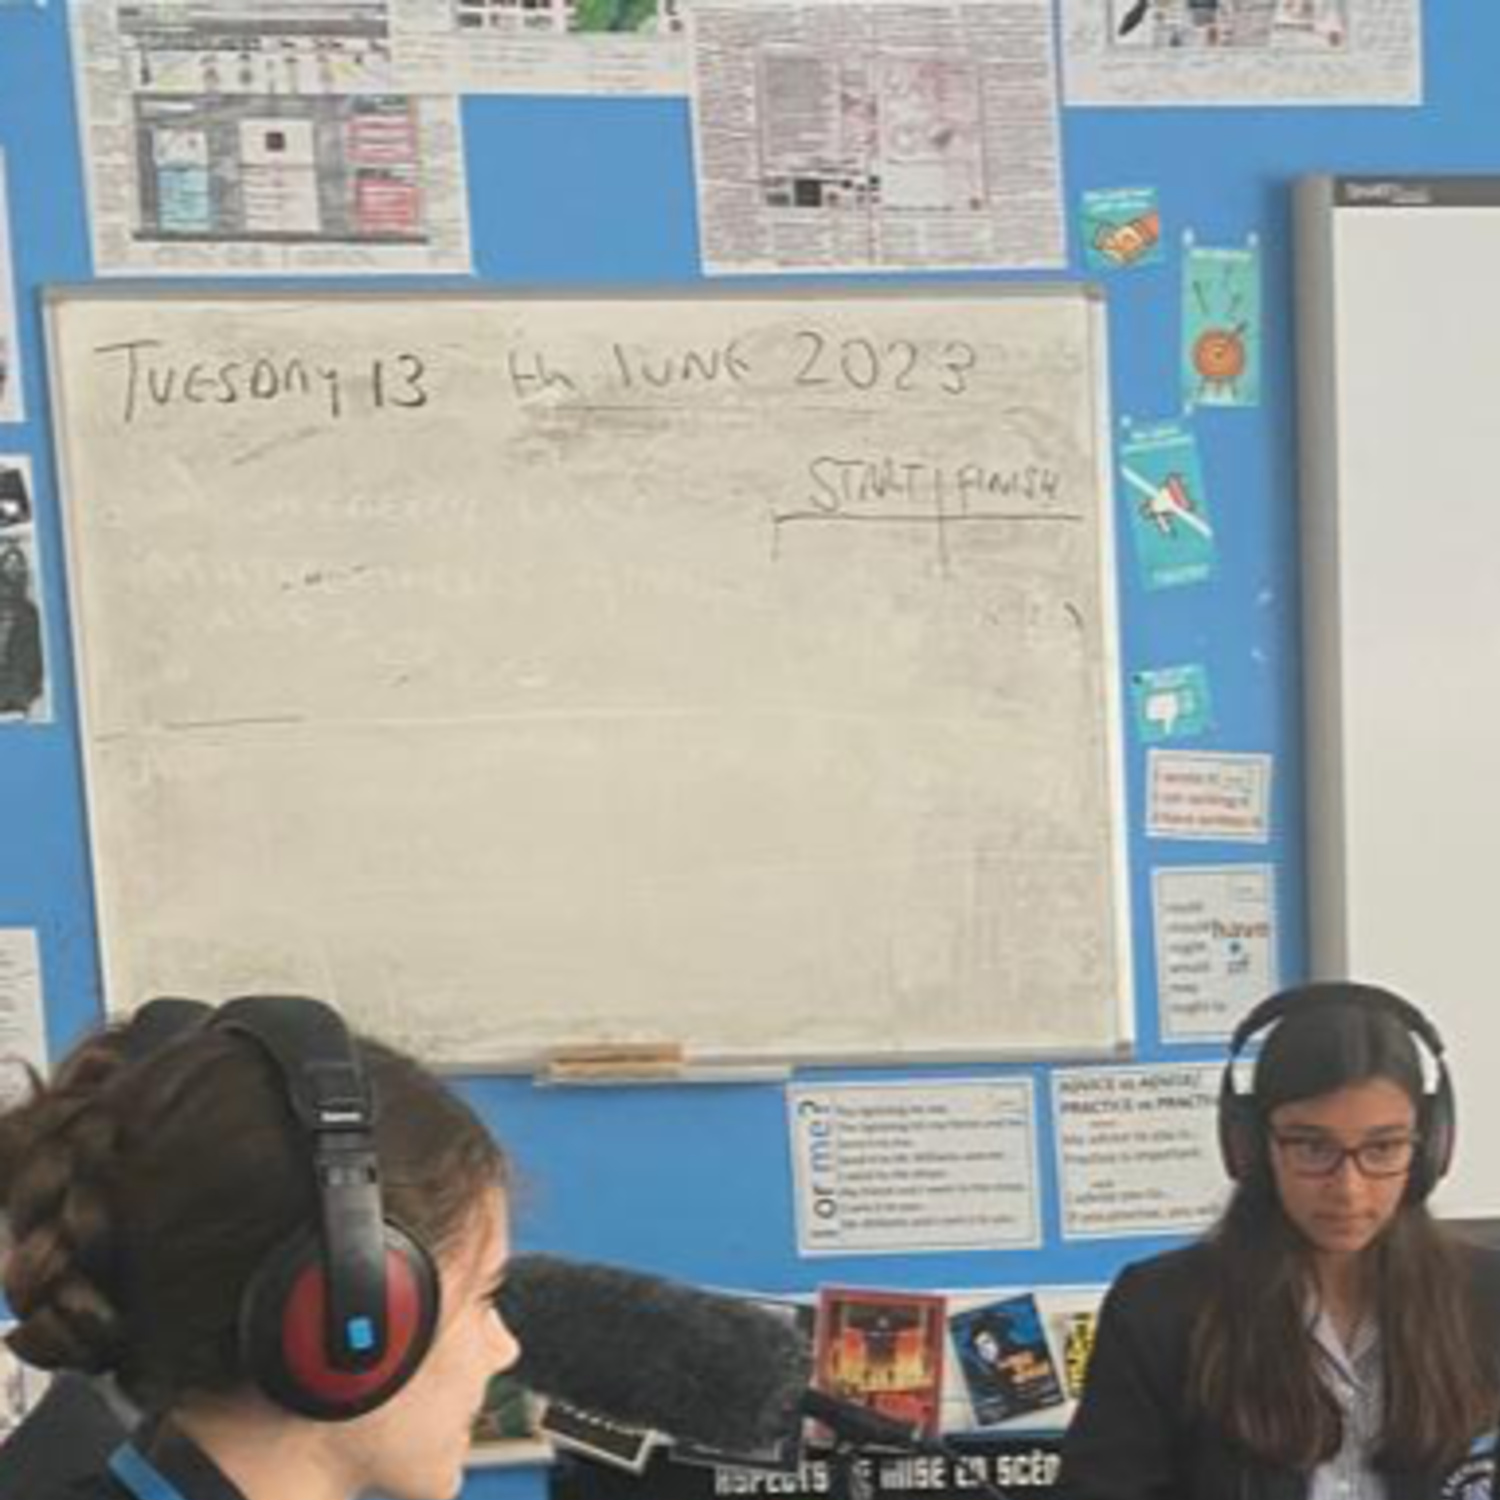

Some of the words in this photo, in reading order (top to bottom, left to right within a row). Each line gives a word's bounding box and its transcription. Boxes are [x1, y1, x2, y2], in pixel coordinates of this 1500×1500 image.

[373, 354, 428, 408] 13
[795, 331, 977, 394] 2023
[808, 457, 927, 513] START
[956, 464, 1060, 511] FINISH
[812, 1187, 837, 1220] or
[880, 1456, 947, 1489] MISE
